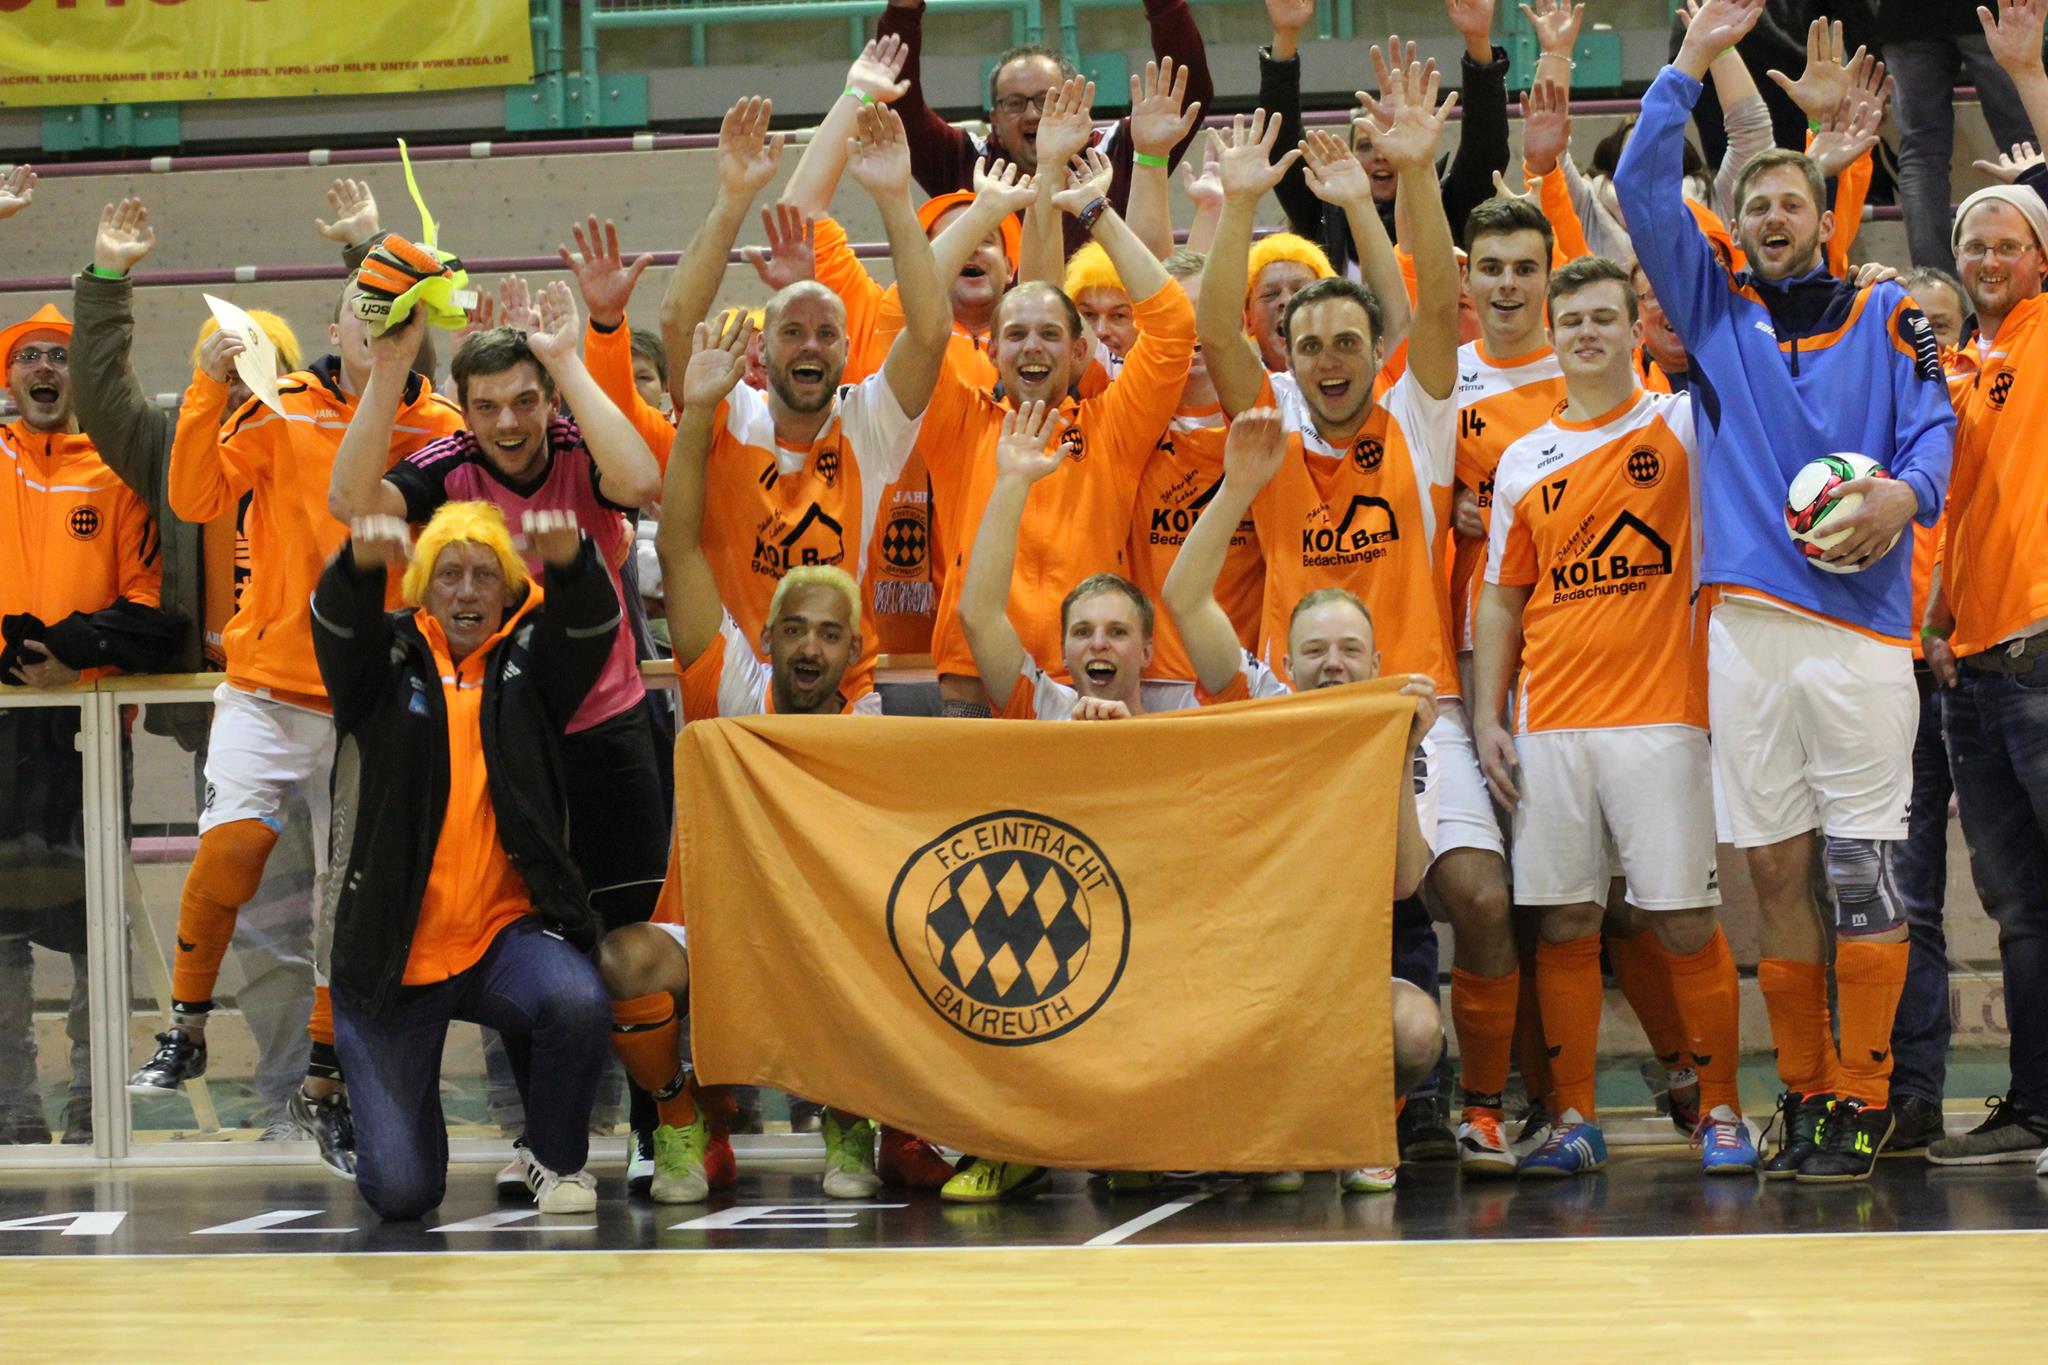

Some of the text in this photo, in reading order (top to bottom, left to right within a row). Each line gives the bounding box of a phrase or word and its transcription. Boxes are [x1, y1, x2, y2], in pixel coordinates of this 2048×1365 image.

[47, 72, 147, 84] SPIELTEILNAHME
[151, 71, 180, 81] ERST
[182, 70, 198, 80] AB
[221, 67, 271, 78] JAHREN.
[275, 64, 310, 75] INFOS
[314, 64, 340, 74] UND
[344, 62, 377, 72] HILFE
[380, 60, 419, 71] UNTER
[1462, 408, 1486, 439] 14
[1537, 453, 1564, 469] erima
[1542, 478, 1568, 514] 17
[1302, 528, 1370, 553] KOLB
[1303, 547, 1387, 567] Bedachungen
[1551, 555, 1630, 591] KOLB
[1553, 581, 1647, 605] Bedachungen
[934, 822, 1110, 892] F.C. EINTRACHT
[934, 985, 1074, 1036] BAYREUTH
